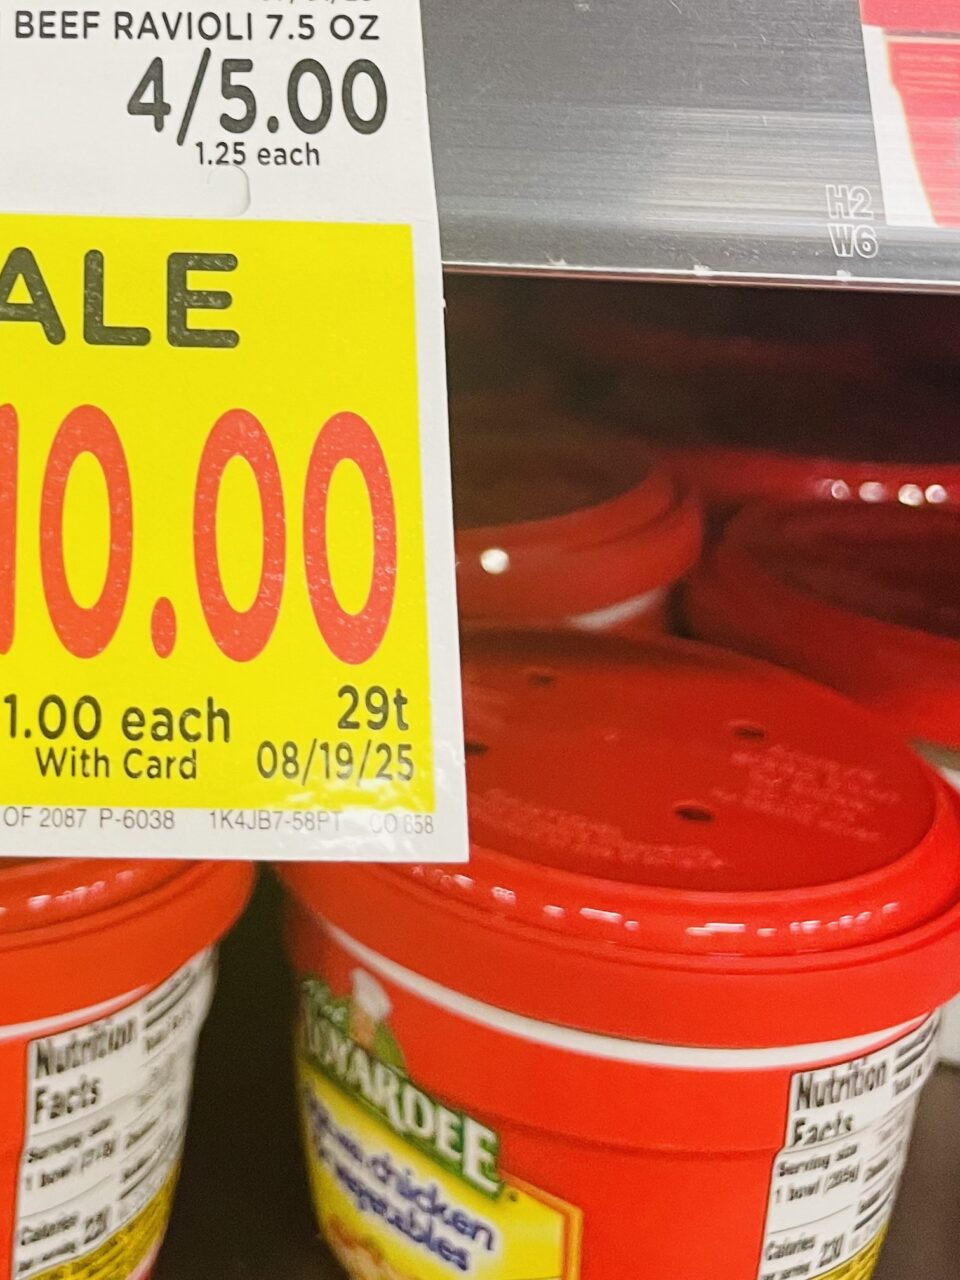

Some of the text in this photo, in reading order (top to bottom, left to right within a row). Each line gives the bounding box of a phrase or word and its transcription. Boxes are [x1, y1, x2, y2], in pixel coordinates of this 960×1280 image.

[16, 11, 99, 39] BEEF
[115, 11, 251, 40] RAVIOLI
[267, 14, 315, 41] 7.5
[331, 15, 380, 42] OZ
[127, 48, 388, 146] 4/5.00
[195, 143, 320, 167] 1.25 each
[825, 185, 874, 219] H2
[827, 224, 878, 258] W6
[4, 694, 231, 742] 1.00 each
[337, 685, 409, 731] 29t
[36, 746, 197, 779] With Card
[257, 738, 415, 786] 08/19/25
[3, 807, 32, 827] OF
[39, 808, 86, 829] 2087
[98, 808, 175, 830] P-6038
[796, 1056, 887, 1112] Nutrition
[793, 1110, 853, 1147] Facts
